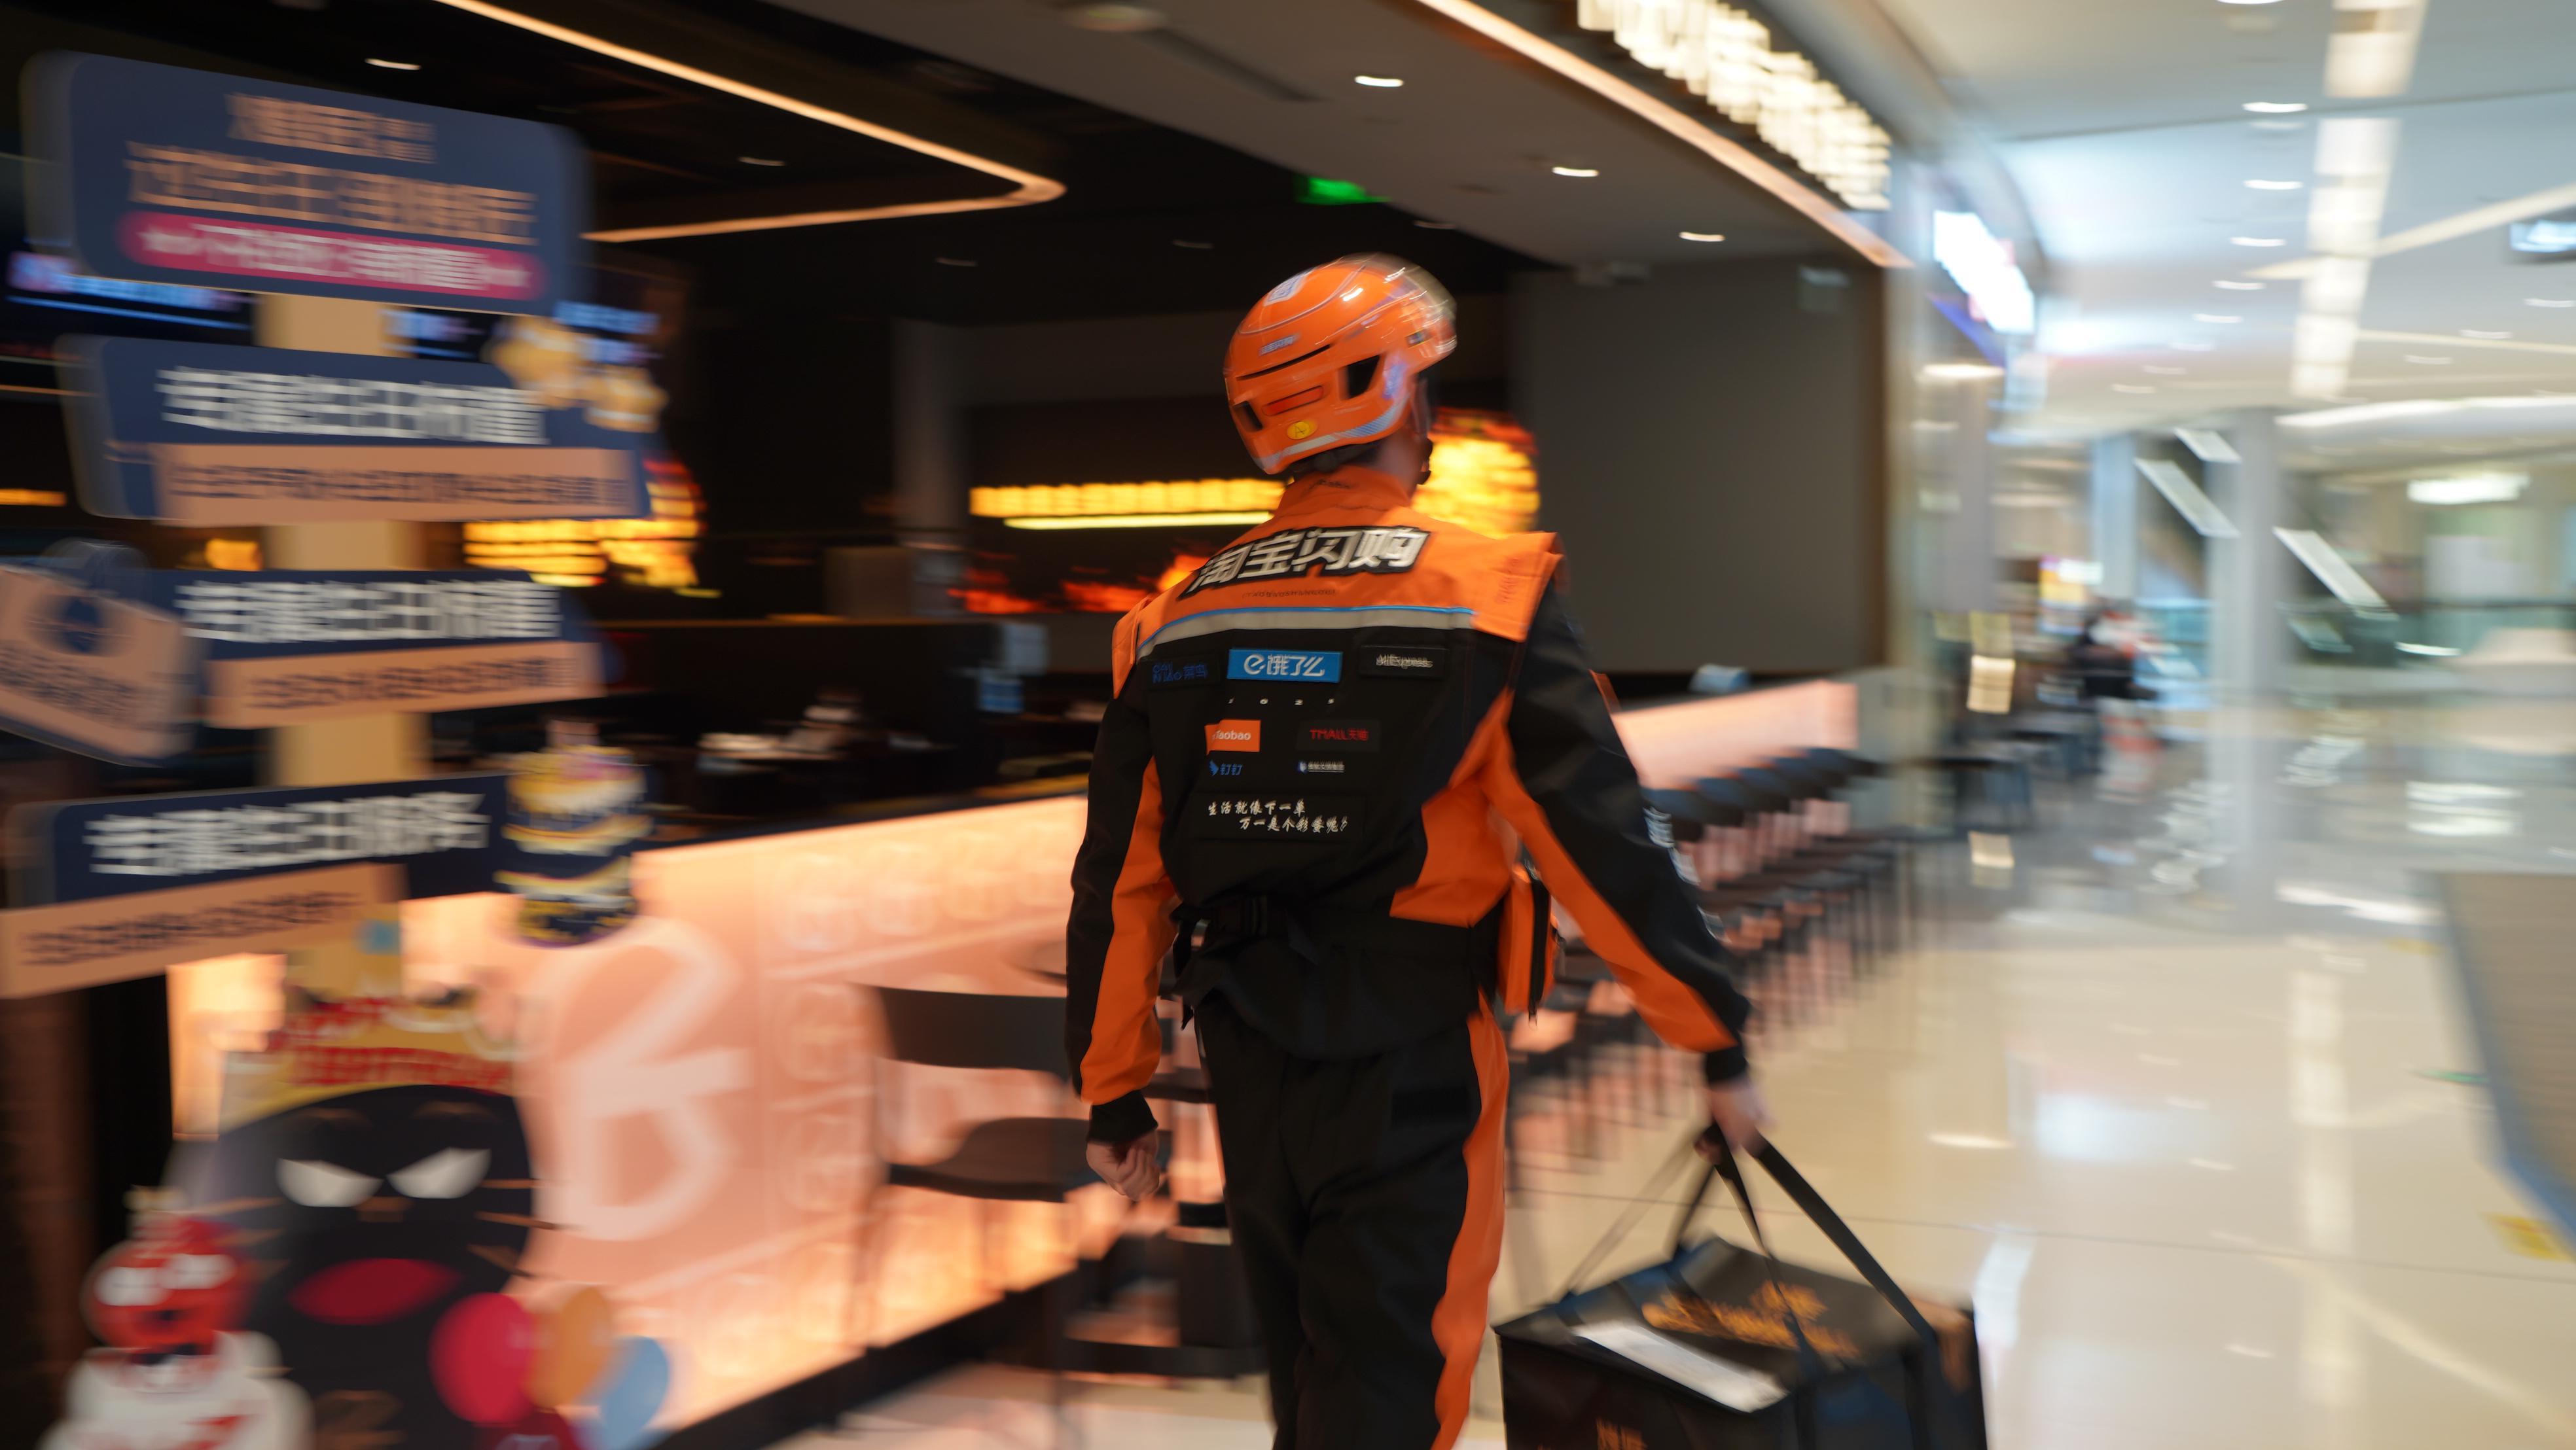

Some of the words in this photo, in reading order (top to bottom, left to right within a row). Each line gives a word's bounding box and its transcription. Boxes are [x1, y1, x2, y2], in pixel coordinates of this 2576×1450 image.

[1185, 525, 1430, 595] 淘宝闪购
[1220, 763, 1242, 775] 钉钉
[1208, 798, 1305, 817] 生活就像下一单
